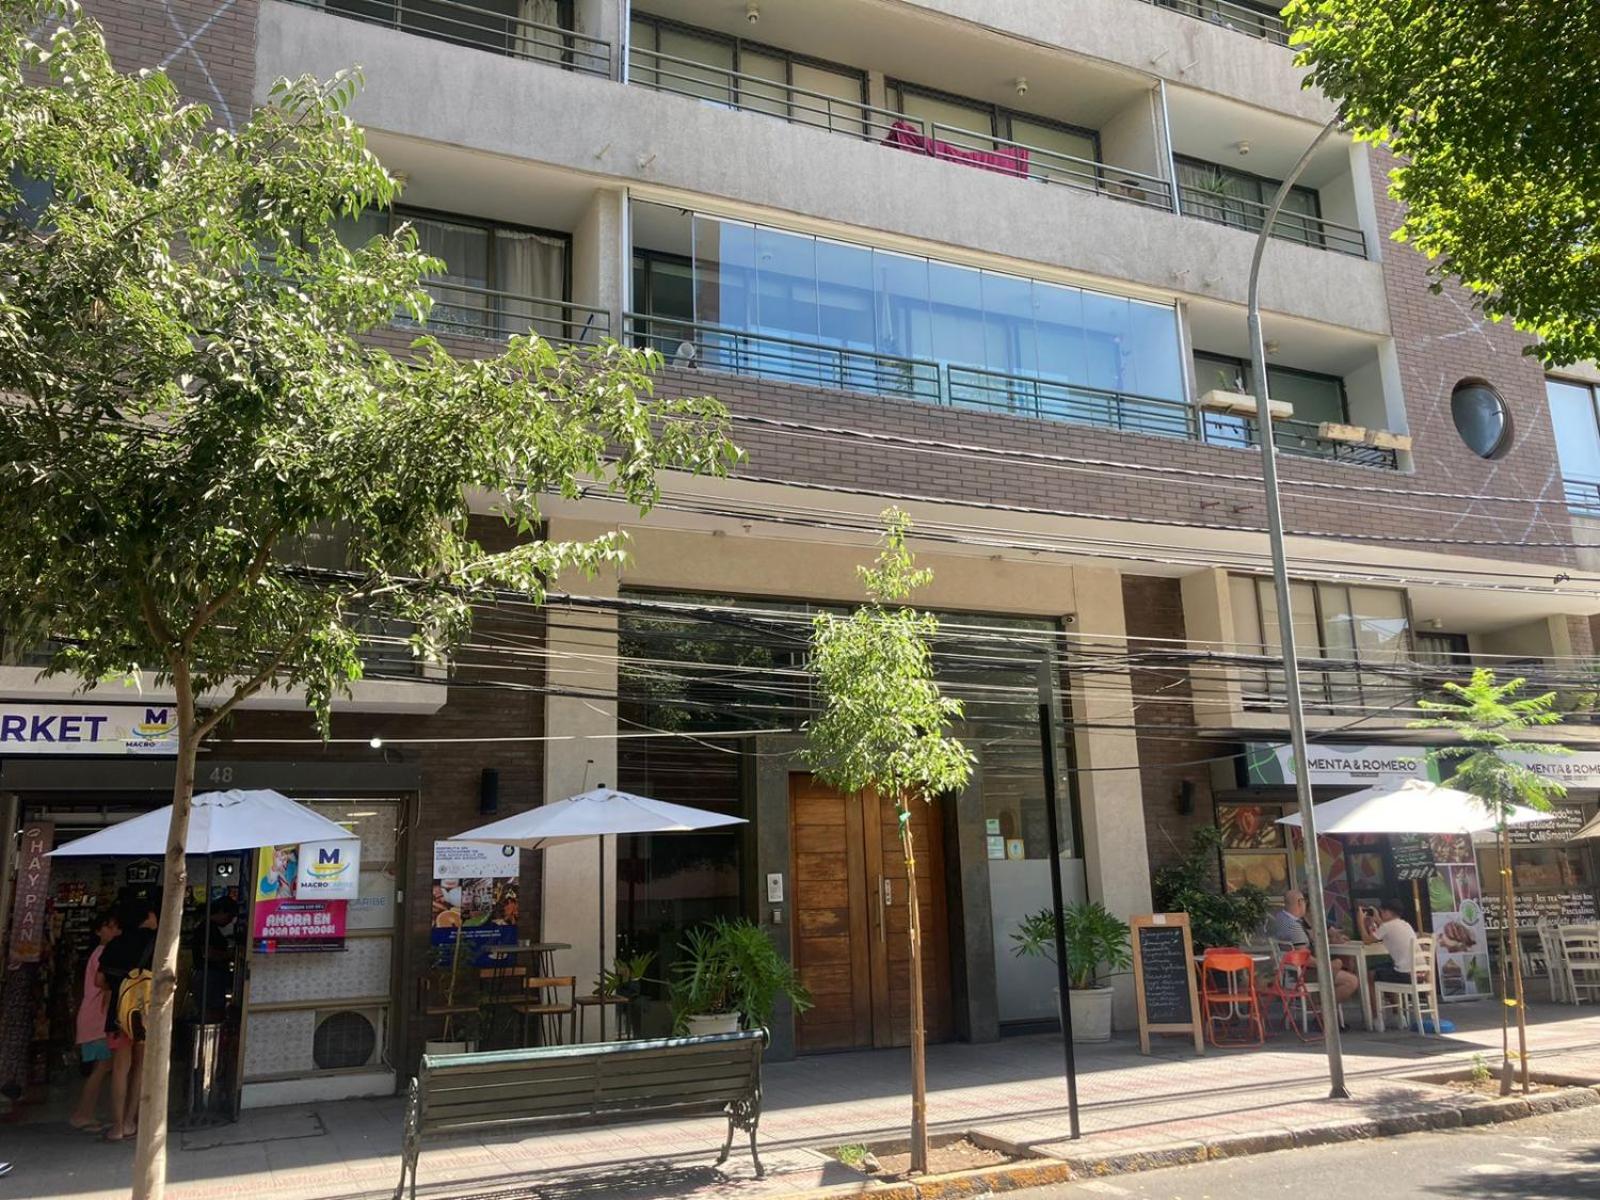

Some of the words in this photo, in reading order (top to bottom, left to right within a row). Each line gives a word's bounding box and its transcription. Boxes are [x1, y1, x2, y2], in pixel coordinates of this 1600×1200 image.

[0, 715, 107, 742] RKET
[1308, 759, 1352, 769] MENTA
[1363, 760, 1417, 771] ROMERO
[209, 767, 233, 783] 48
[266, 914, 312, 927] AHORA
[313, 912, 331, 925] EN
[289, 926, 300, 936] DE
